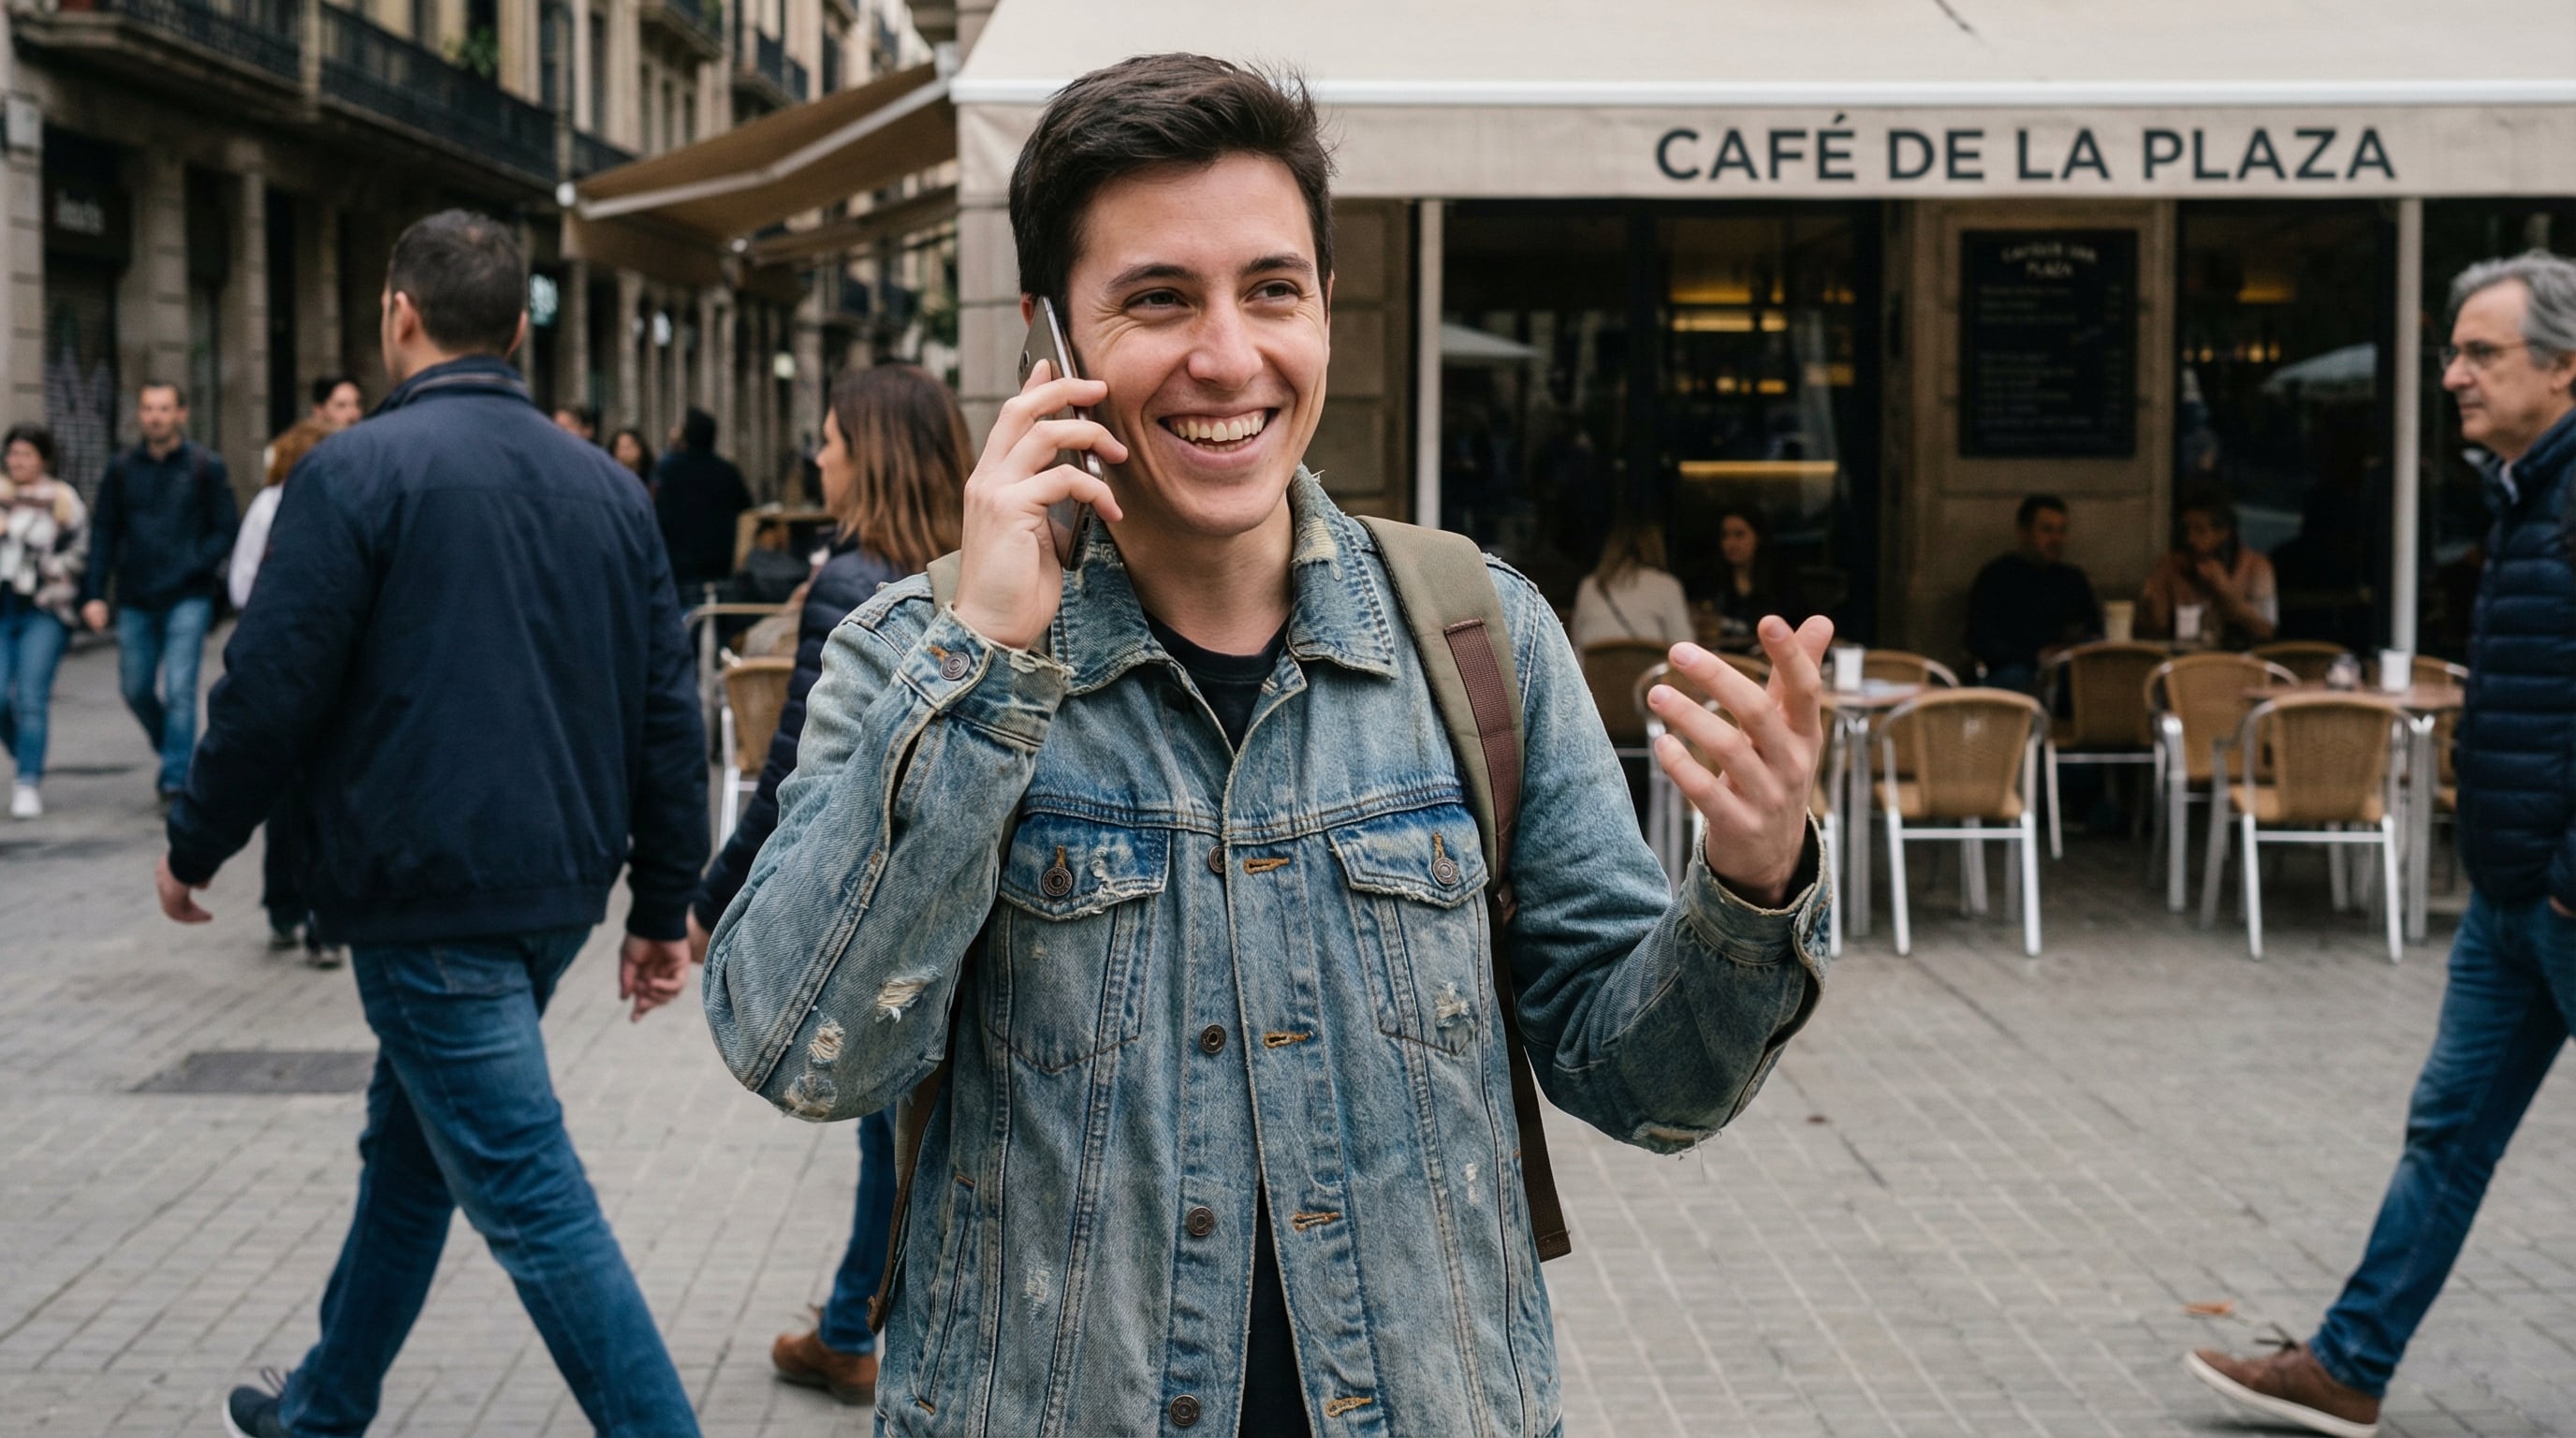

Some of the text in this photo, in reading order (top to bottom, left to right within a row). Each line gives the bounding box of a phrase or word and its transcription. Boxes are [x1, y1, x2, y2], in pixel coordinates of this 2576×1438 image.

[1656, 113, 2395, 181] CAFÉ DE LA PLAZA
